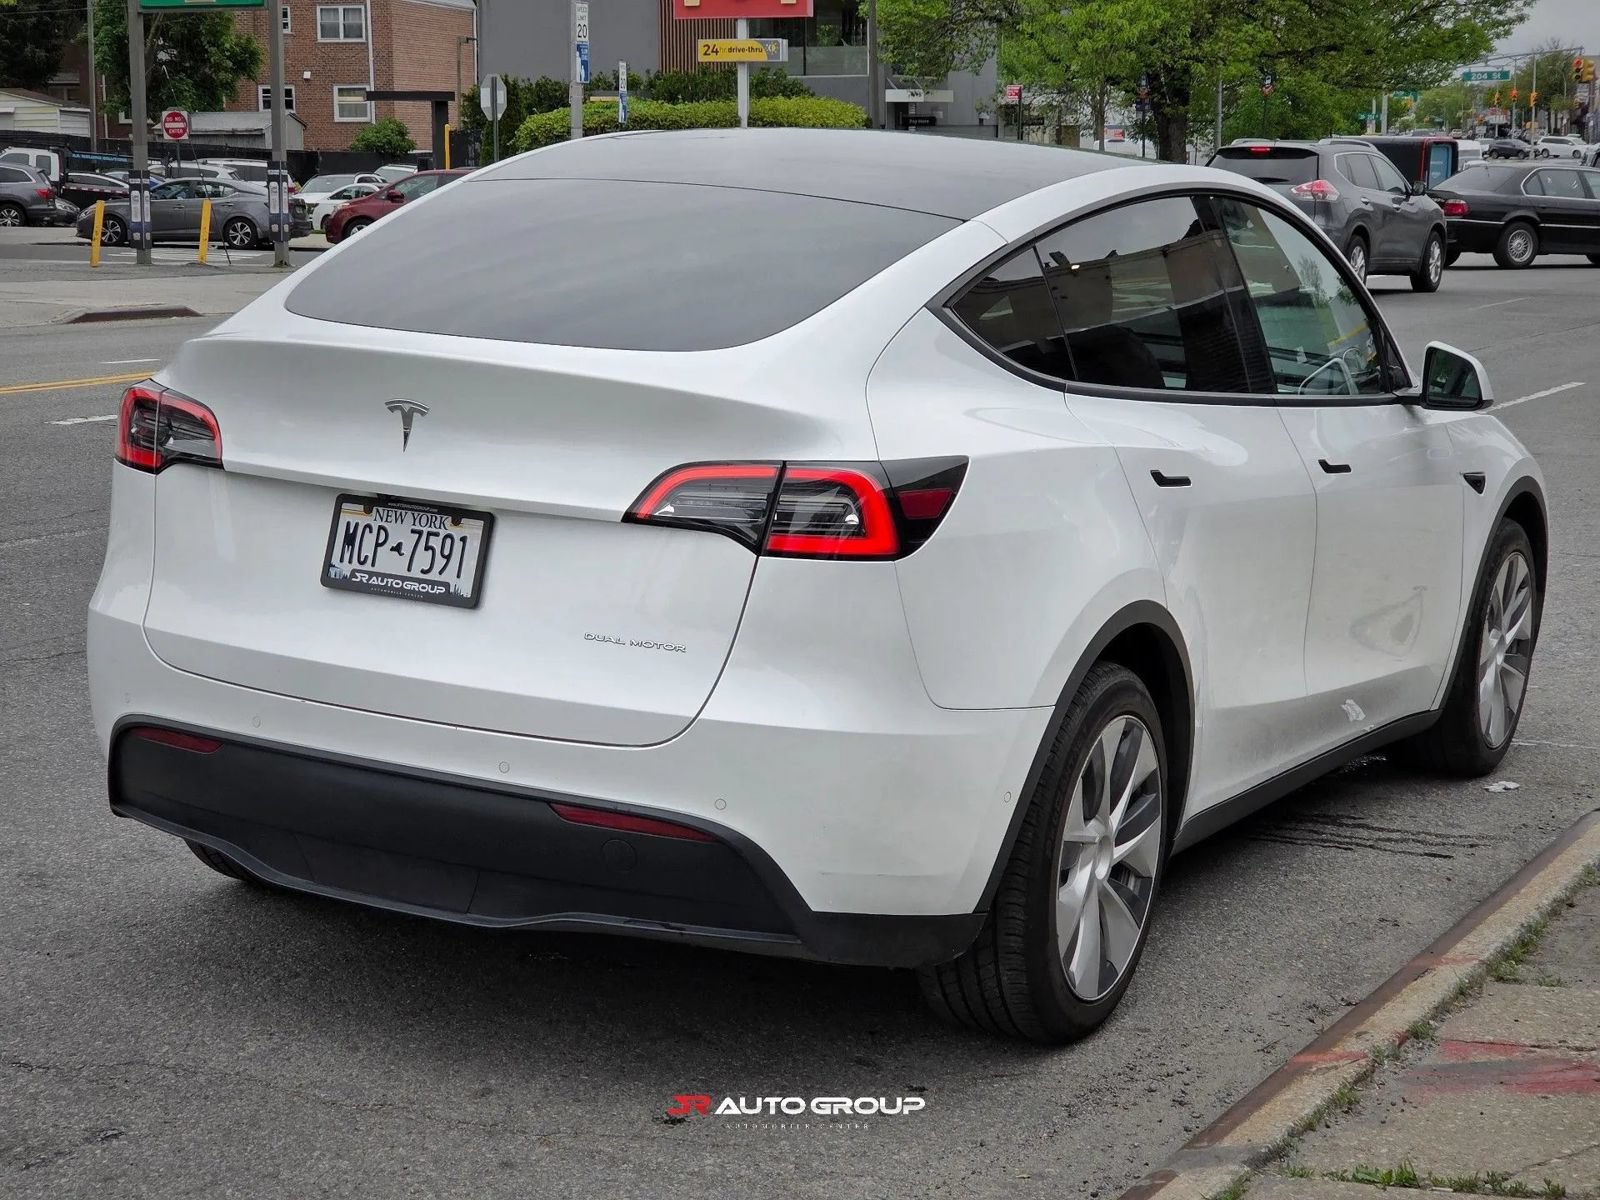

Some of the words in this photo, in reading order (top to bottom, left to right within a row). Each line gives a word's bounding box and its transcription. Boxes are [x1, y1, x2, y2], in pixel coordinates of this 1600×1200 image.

[577, 23, 588, 38] 20
[703, 44, 719, 56] 24
[728, 45, 763, 54] drive-thru
[1471, 72, 1488, 80] 204
[1492, 72, 1502, 80] St
[373, 508, 408, 525] NEW
[411, 510, 450, 530] YORK
[339, 520, 389, 568] MCP
[406, 528, 468, 579] 7591
[367, 576, 403, 588] AUTO
[402, 581, 446, 594] GROUP
[584, 632, 625, 646] DUAL
[630, 639, 687, 653] MOTOR
